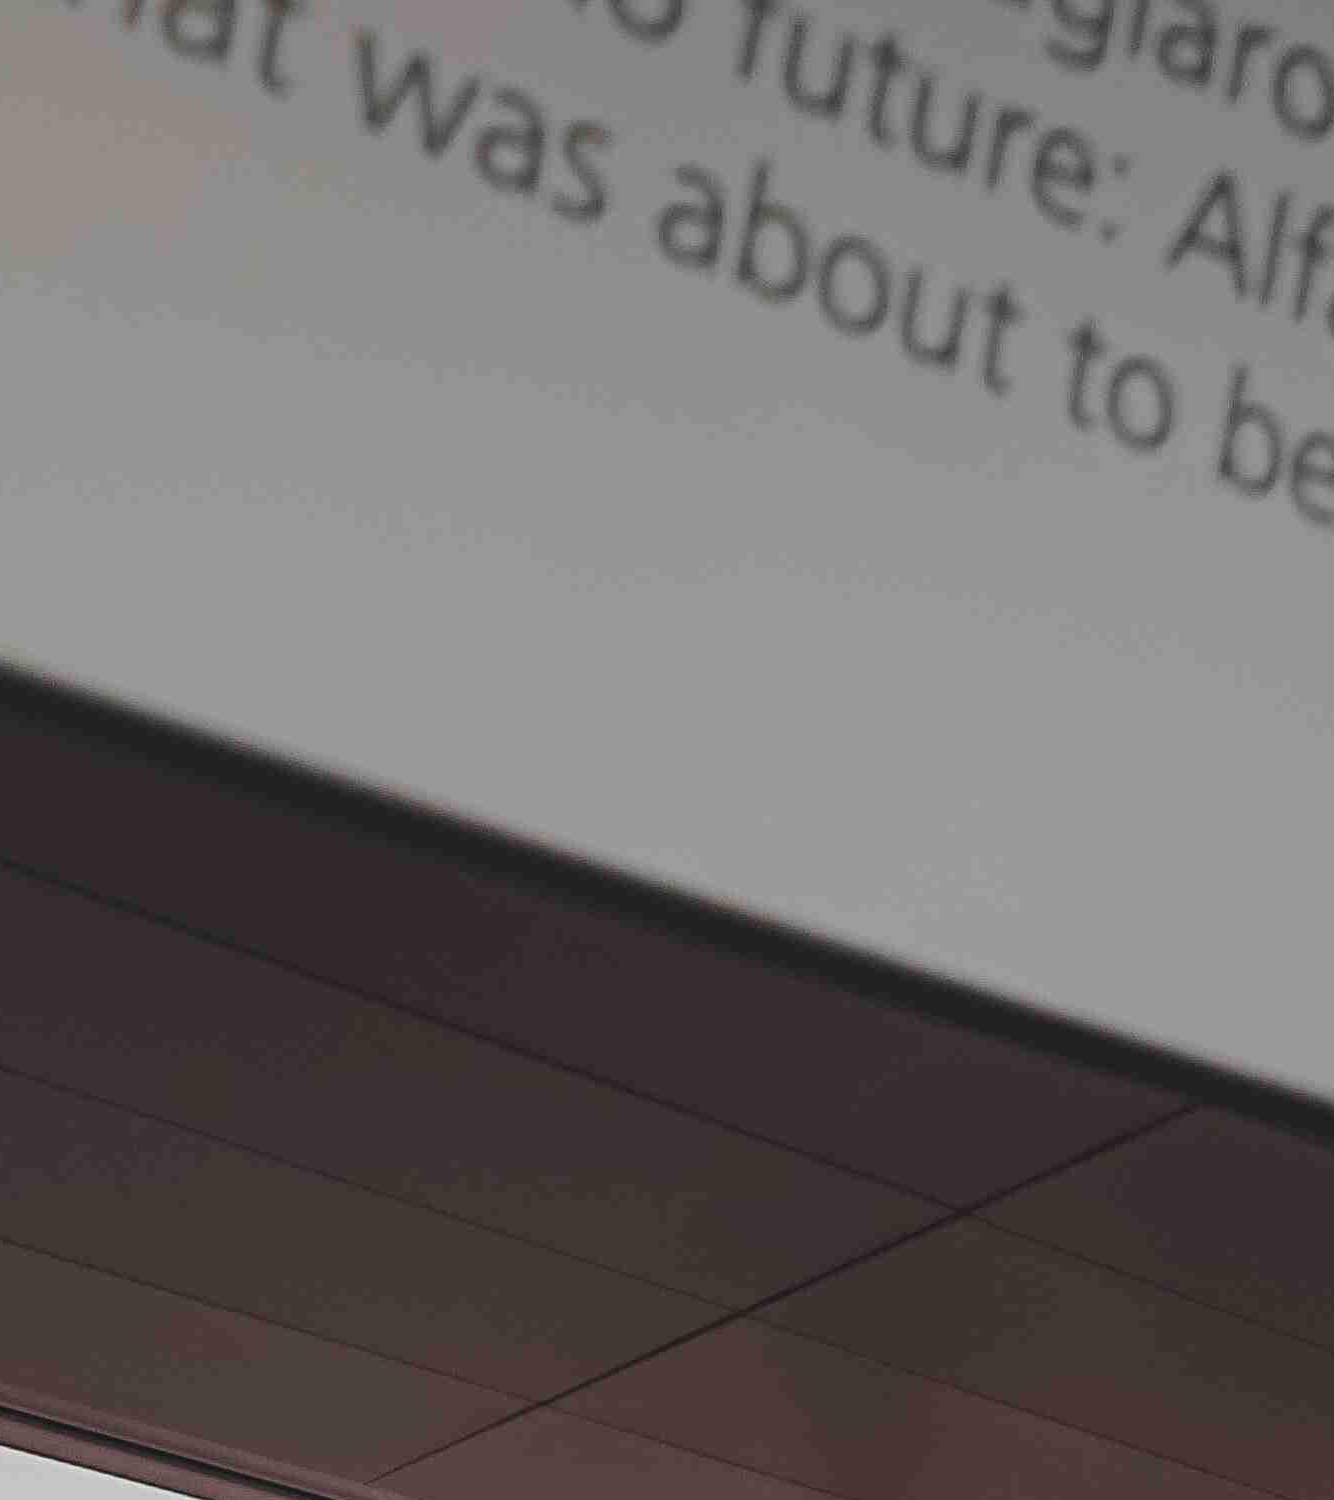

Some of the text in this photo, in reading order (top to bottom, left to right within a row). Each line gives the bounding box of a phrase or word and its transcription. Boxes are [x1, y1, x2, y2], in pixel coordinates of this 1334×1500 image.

[353, 27, 613, 227] was
[653, 158, 1025, 399] about
[1065, 316, 1178, 456] to
[733, 0, 1131, 244] future:
